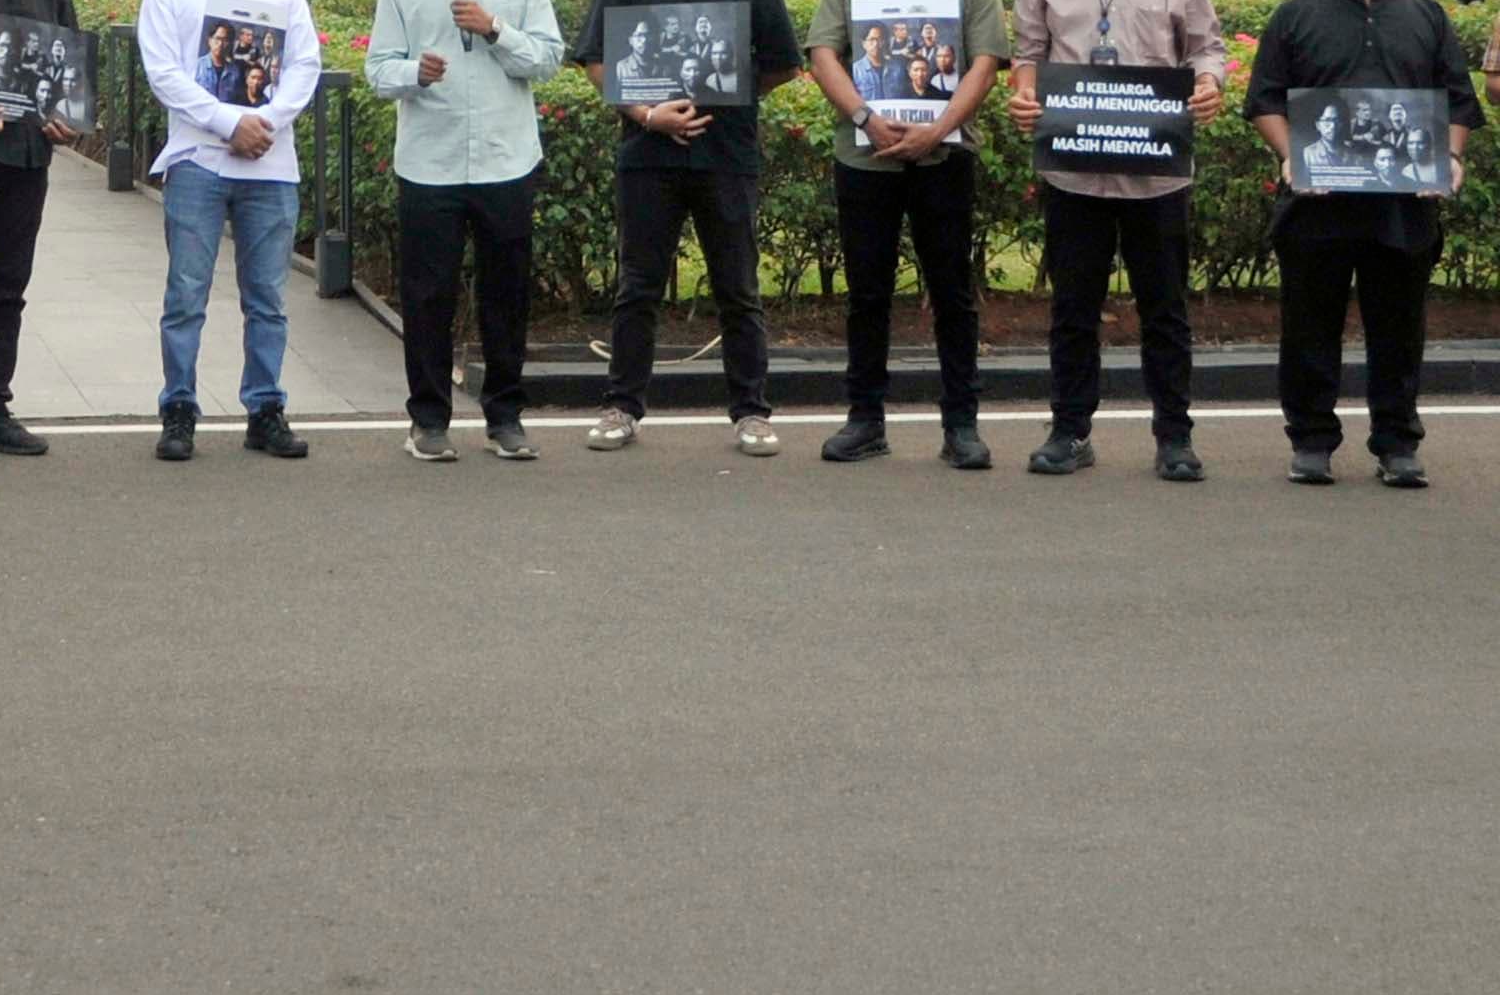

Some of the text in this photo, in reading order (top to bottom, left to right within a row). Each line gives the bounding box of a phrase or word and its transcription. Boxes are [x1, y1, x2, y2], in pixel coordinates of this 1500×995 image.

[1075, 81, 1155, 96] 8 KELUARGA
[1046, 94, 1183, 114] MASIH MENUNGGU
[1076, 123, 1149, 138] 8 HARAPAN
[1052, 137, 1173, 156] MASIH MENYALA
